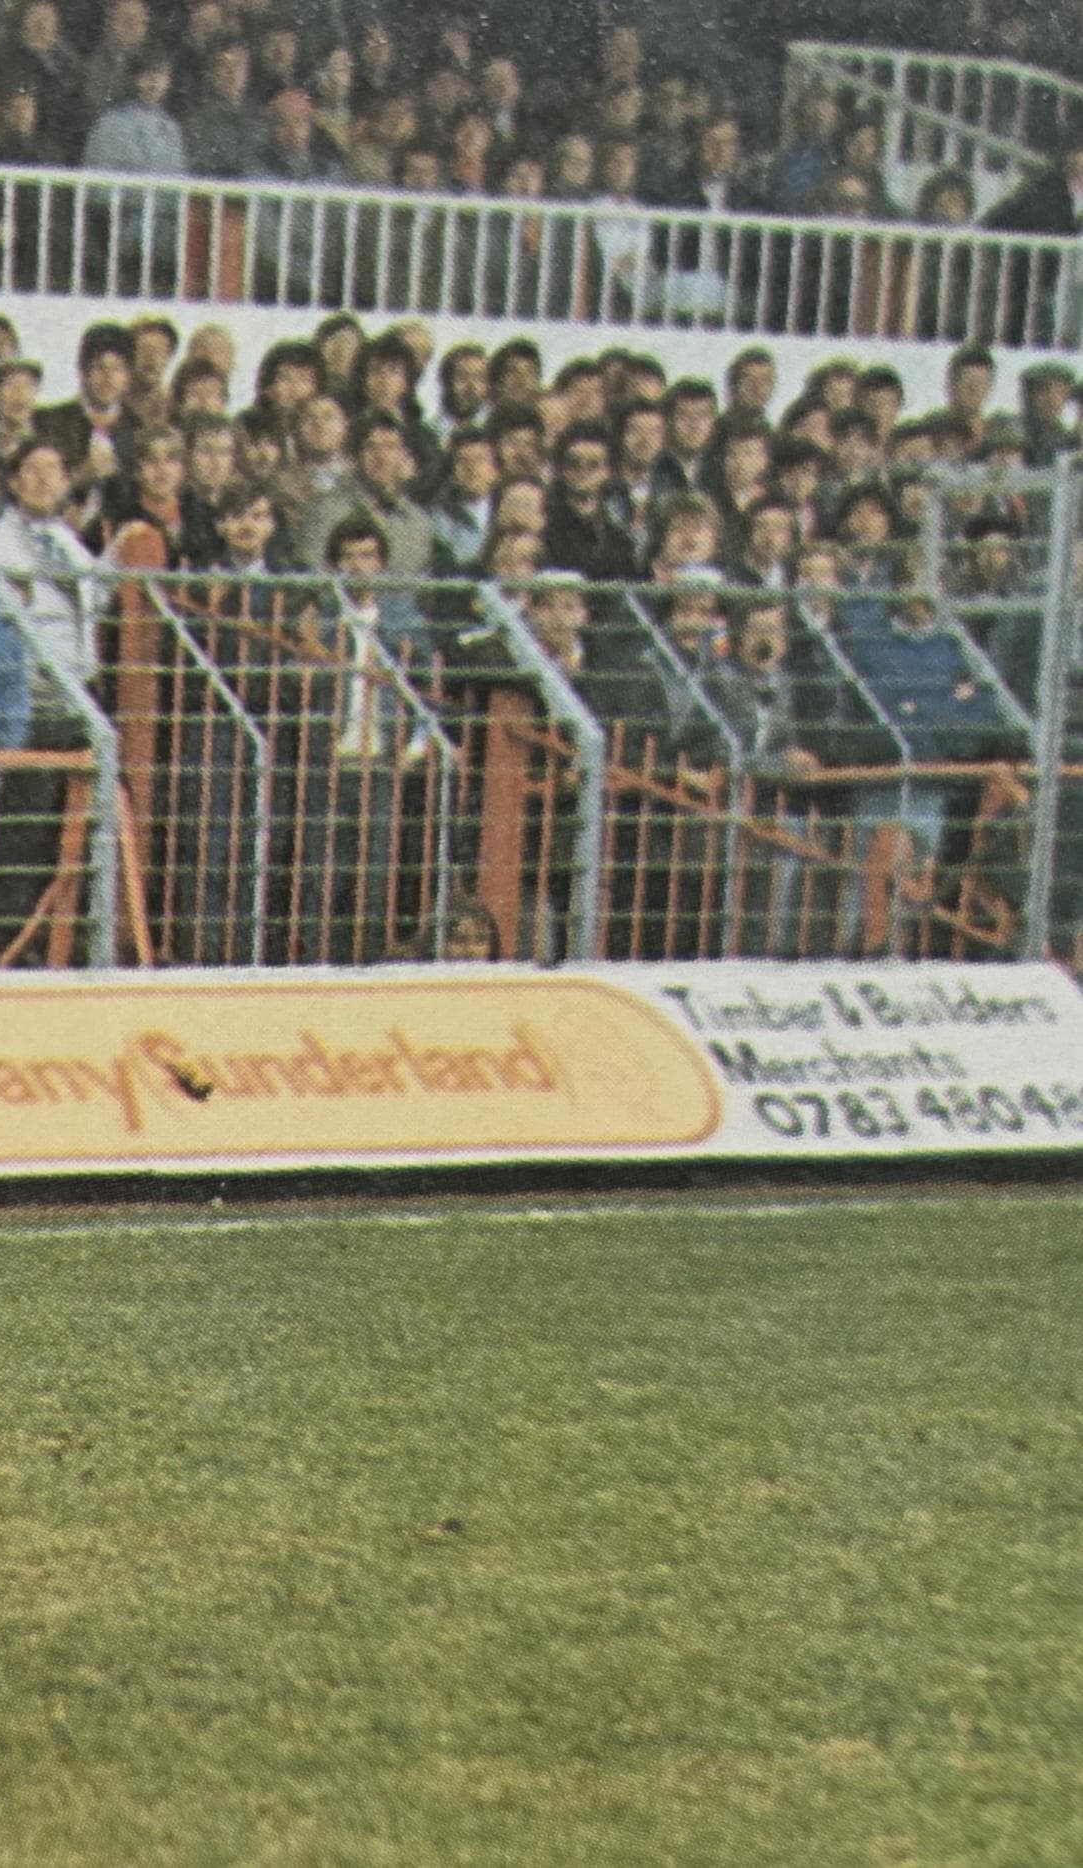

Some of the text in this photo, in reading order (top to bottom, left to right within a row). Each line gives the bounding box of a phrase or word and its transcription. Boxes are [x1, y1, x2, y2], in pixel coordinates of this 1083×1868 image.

[133, 1022, 560, 1103] Sunderland
[708, 1037, 969, 1085] Merchants
[753, 1086, 911, 1139] 0783
